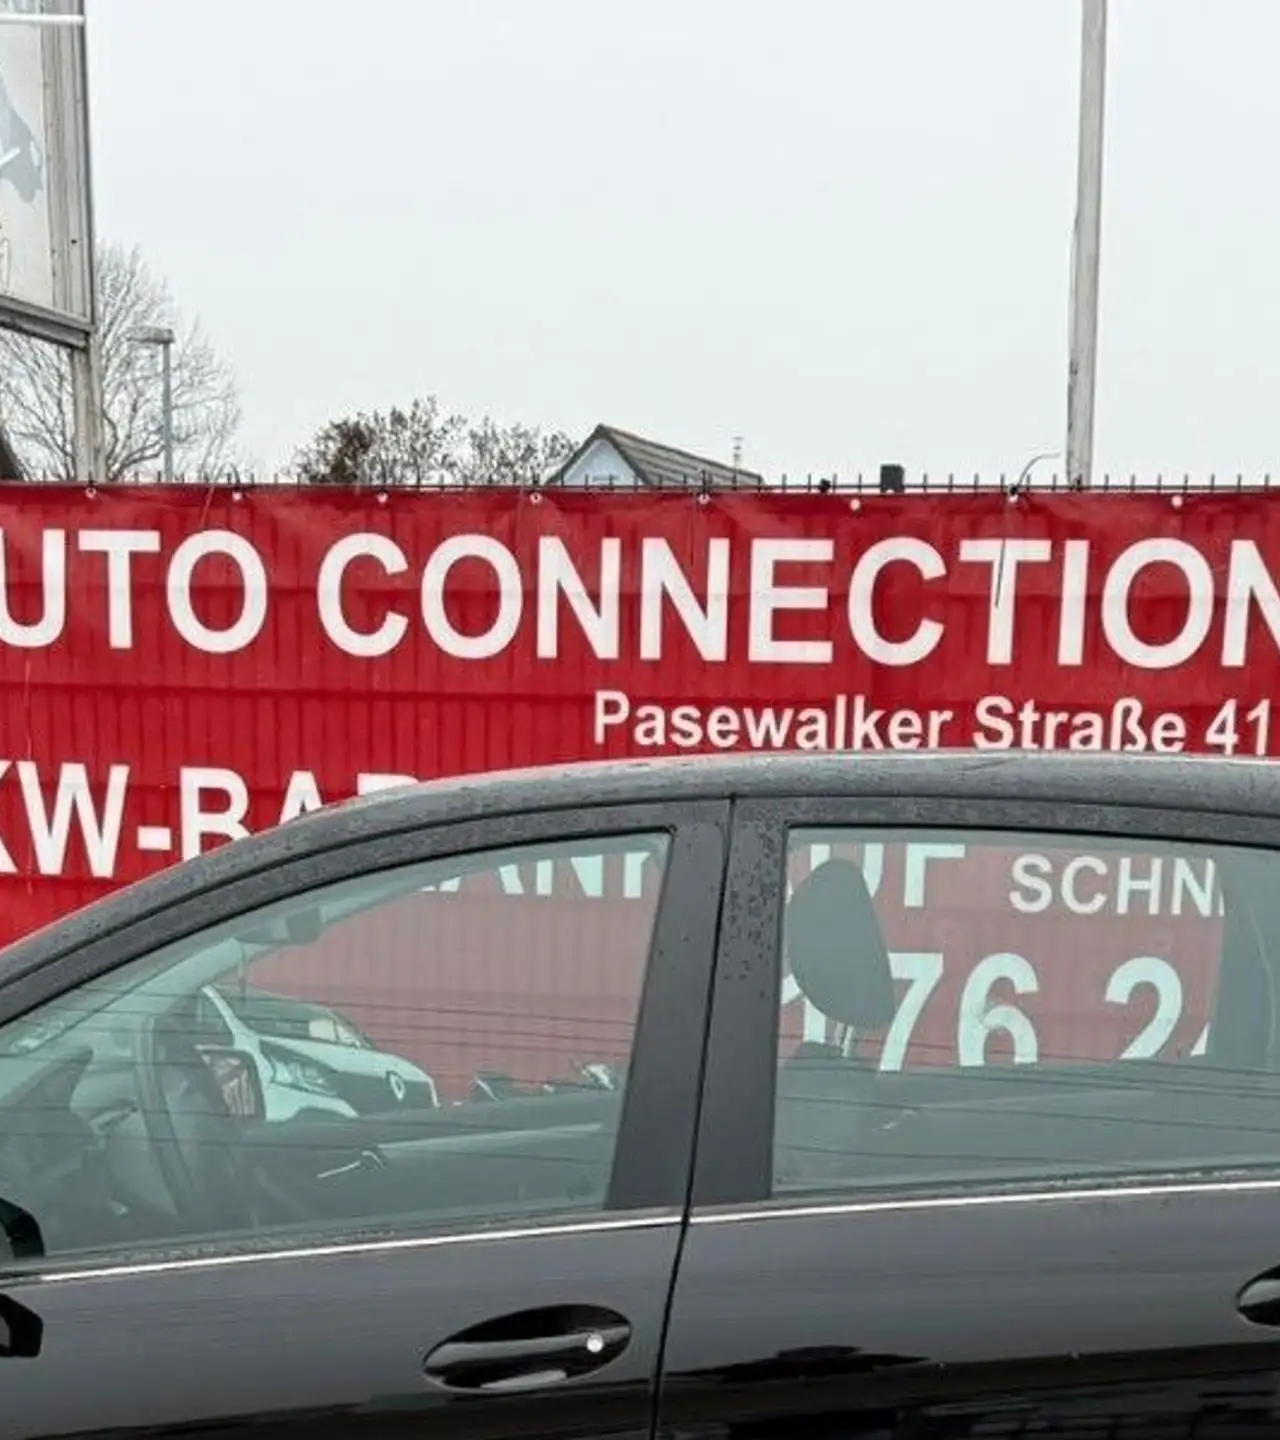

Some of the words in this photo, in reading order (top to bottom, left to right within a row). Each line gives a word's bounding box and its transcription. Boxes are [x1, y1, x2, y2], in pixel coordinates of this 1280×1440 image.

[593, 689, 951, 750] Pasewalker
[973, 695, 1184, 752] Straße
[1205, 698, 1271, 755] 41
